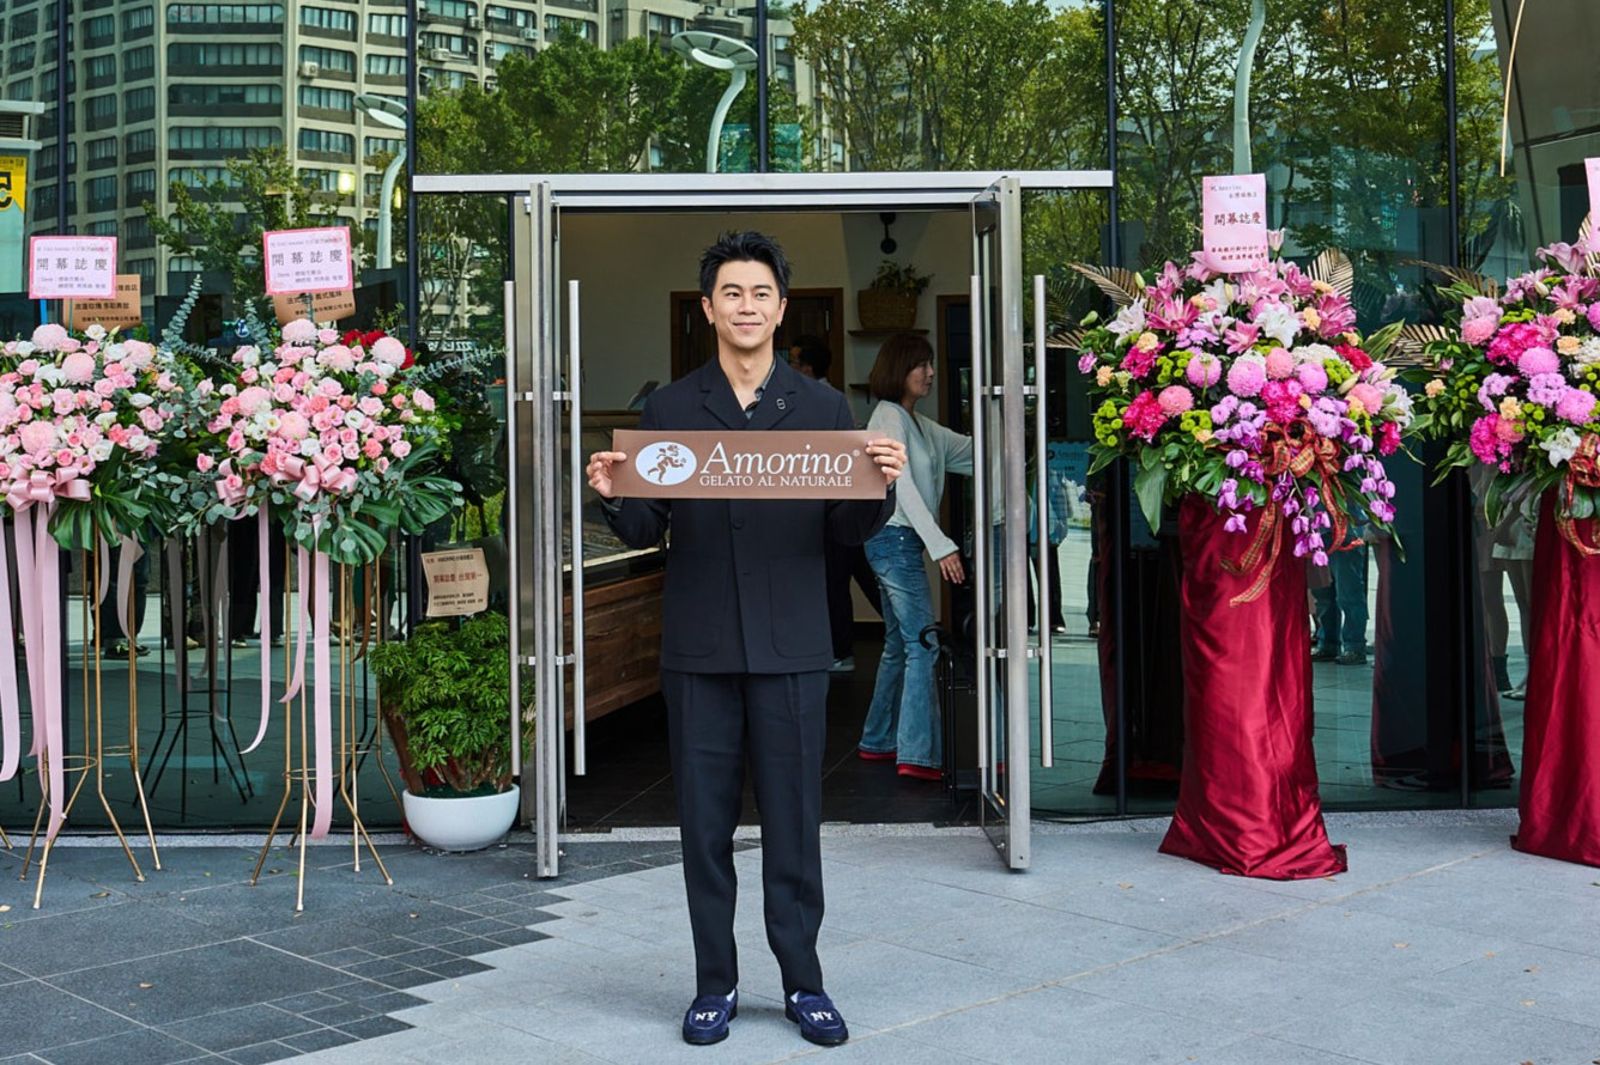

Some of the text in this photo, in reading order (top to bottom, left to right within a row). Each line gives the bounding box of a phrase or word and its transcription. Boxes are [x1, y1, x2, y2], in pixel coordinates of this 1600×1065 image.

[1214, 212, 1261, 226] 開幕誌慶
[36, 257, 108, 271] 開幕誌慶
[271, 249, 343, 266] 開幕誌慶
[700, 475, 852, 487] GELATO AL NATURALE
[695, 1011, 719, 1022] NY
[810, 1010, 834, 1022] NY
